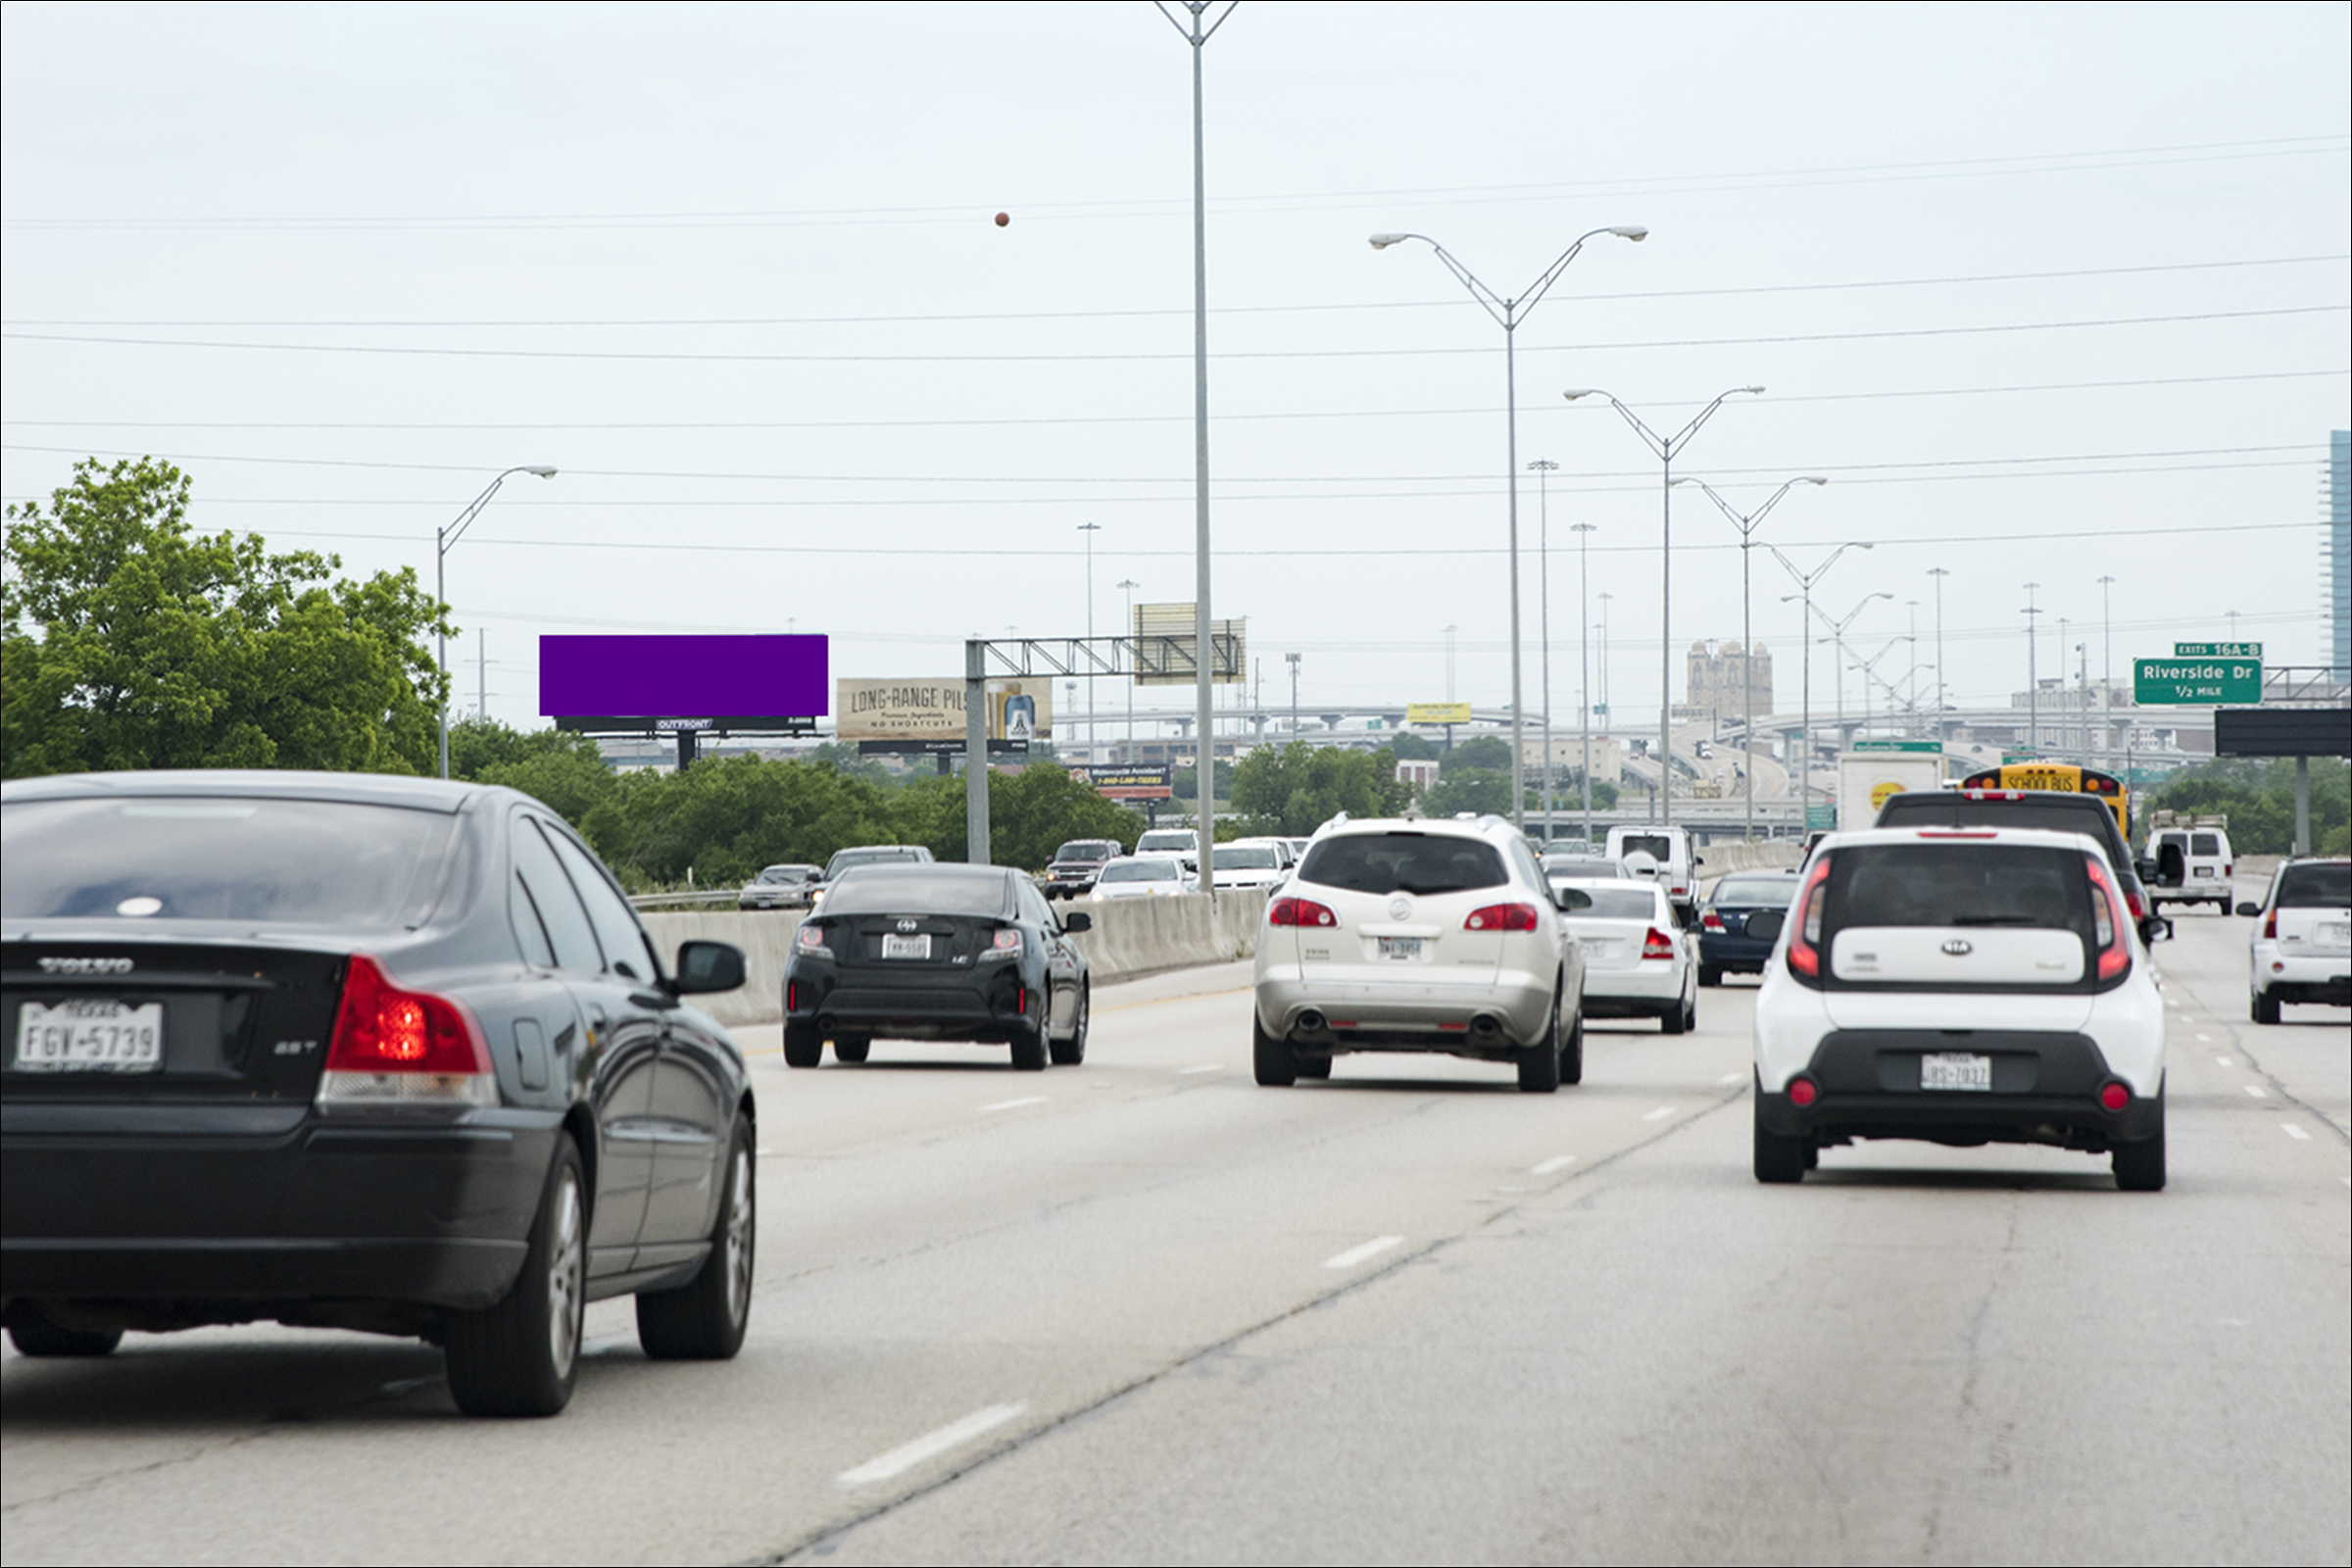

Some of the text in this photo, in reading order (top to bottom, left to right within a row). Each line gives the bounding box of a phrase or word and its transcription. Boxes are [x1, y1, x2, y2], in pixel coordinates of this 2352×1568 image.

[2179, 645, 2207, 655] EXITS
[2143, 664, 2253, 679] Riverside Dr
[851, 687, 938, 713] LONG-RANGE
[2196, 687, 2223, 696] MILE
[2007, 775, 2074, 792] SCHOOL BUS
[37, 956, 134, 974] VOLVO
[25, 1025, 154, 1057] FGV-5739
